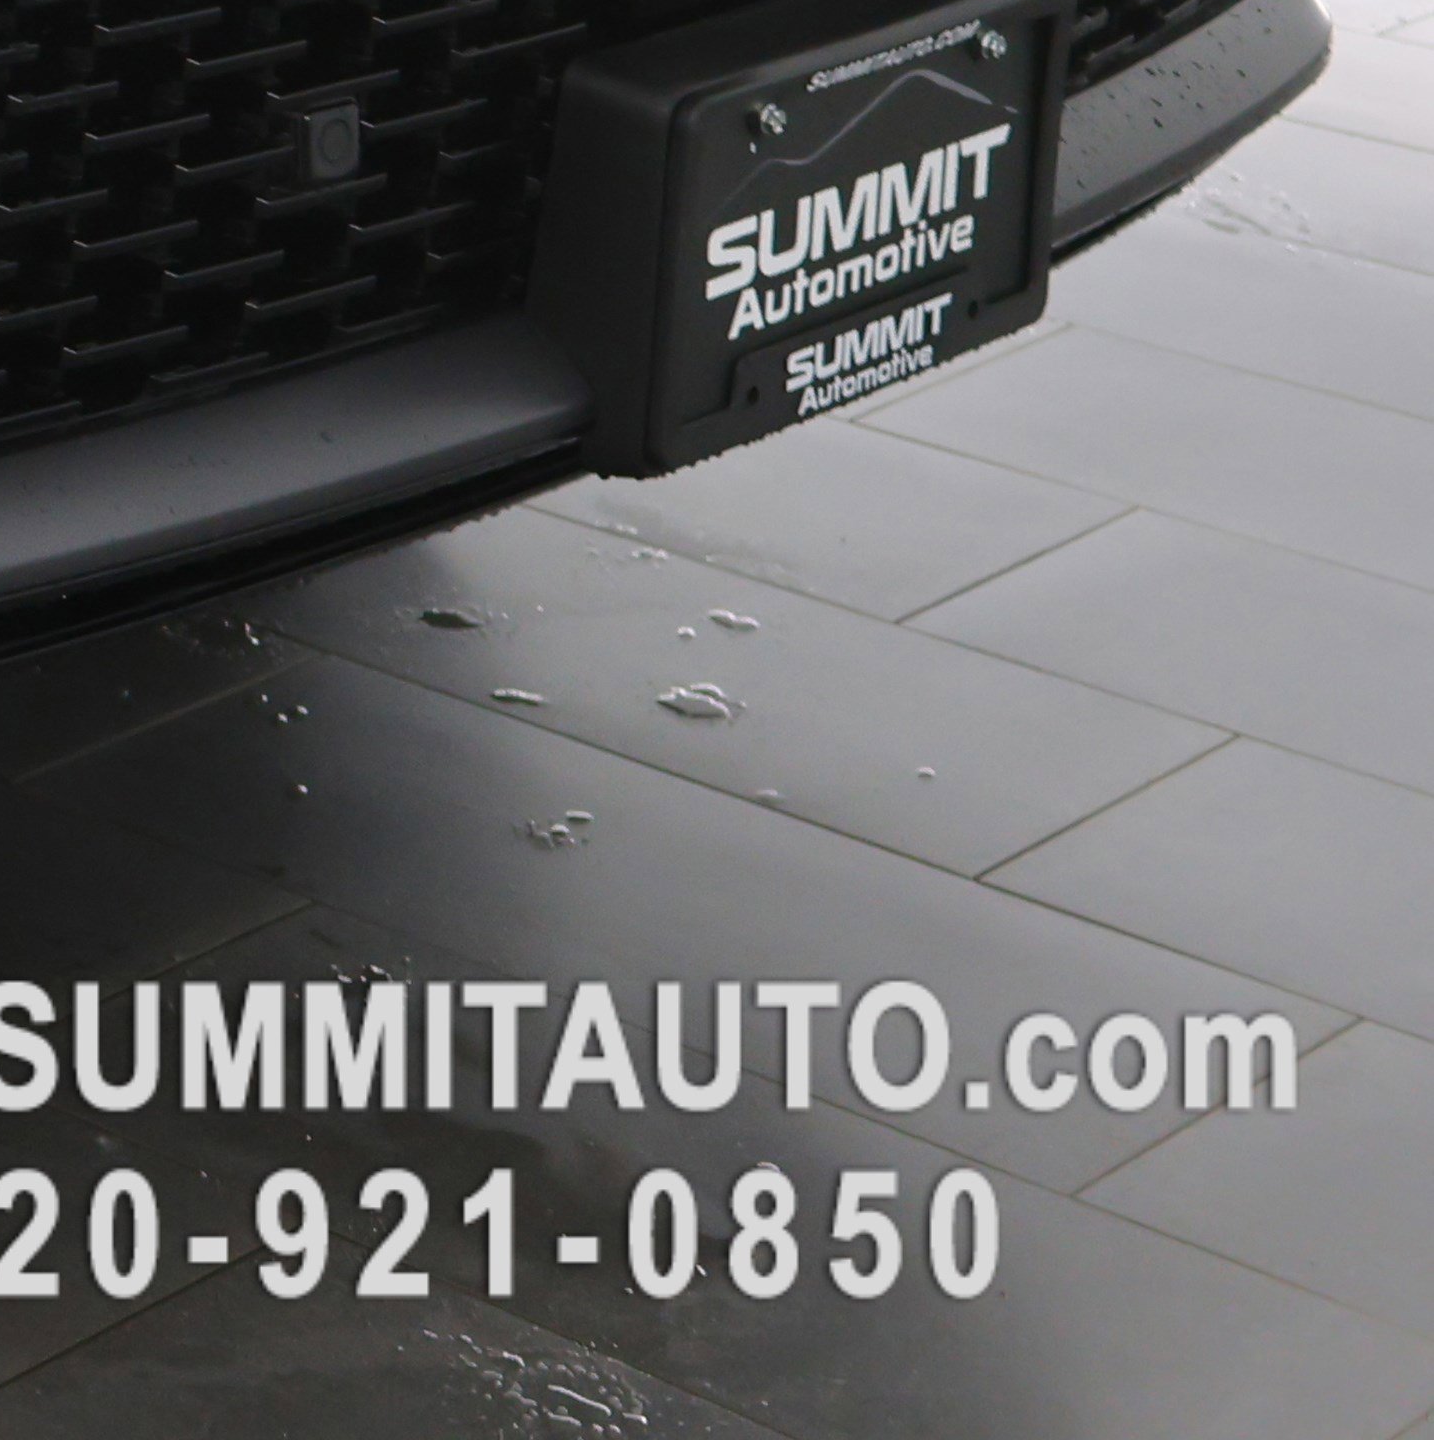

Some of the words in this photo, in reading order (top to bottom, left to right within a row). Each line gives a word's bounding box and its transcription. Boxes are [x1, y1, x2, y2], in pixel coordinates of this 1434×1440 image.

[705, 123, 1011, 301] SUMMIT
[727, 215, 975, 341] Automotive
[785, 293, 953, 392] SUMMIT
[797, 343, 935, 416] Automotive
